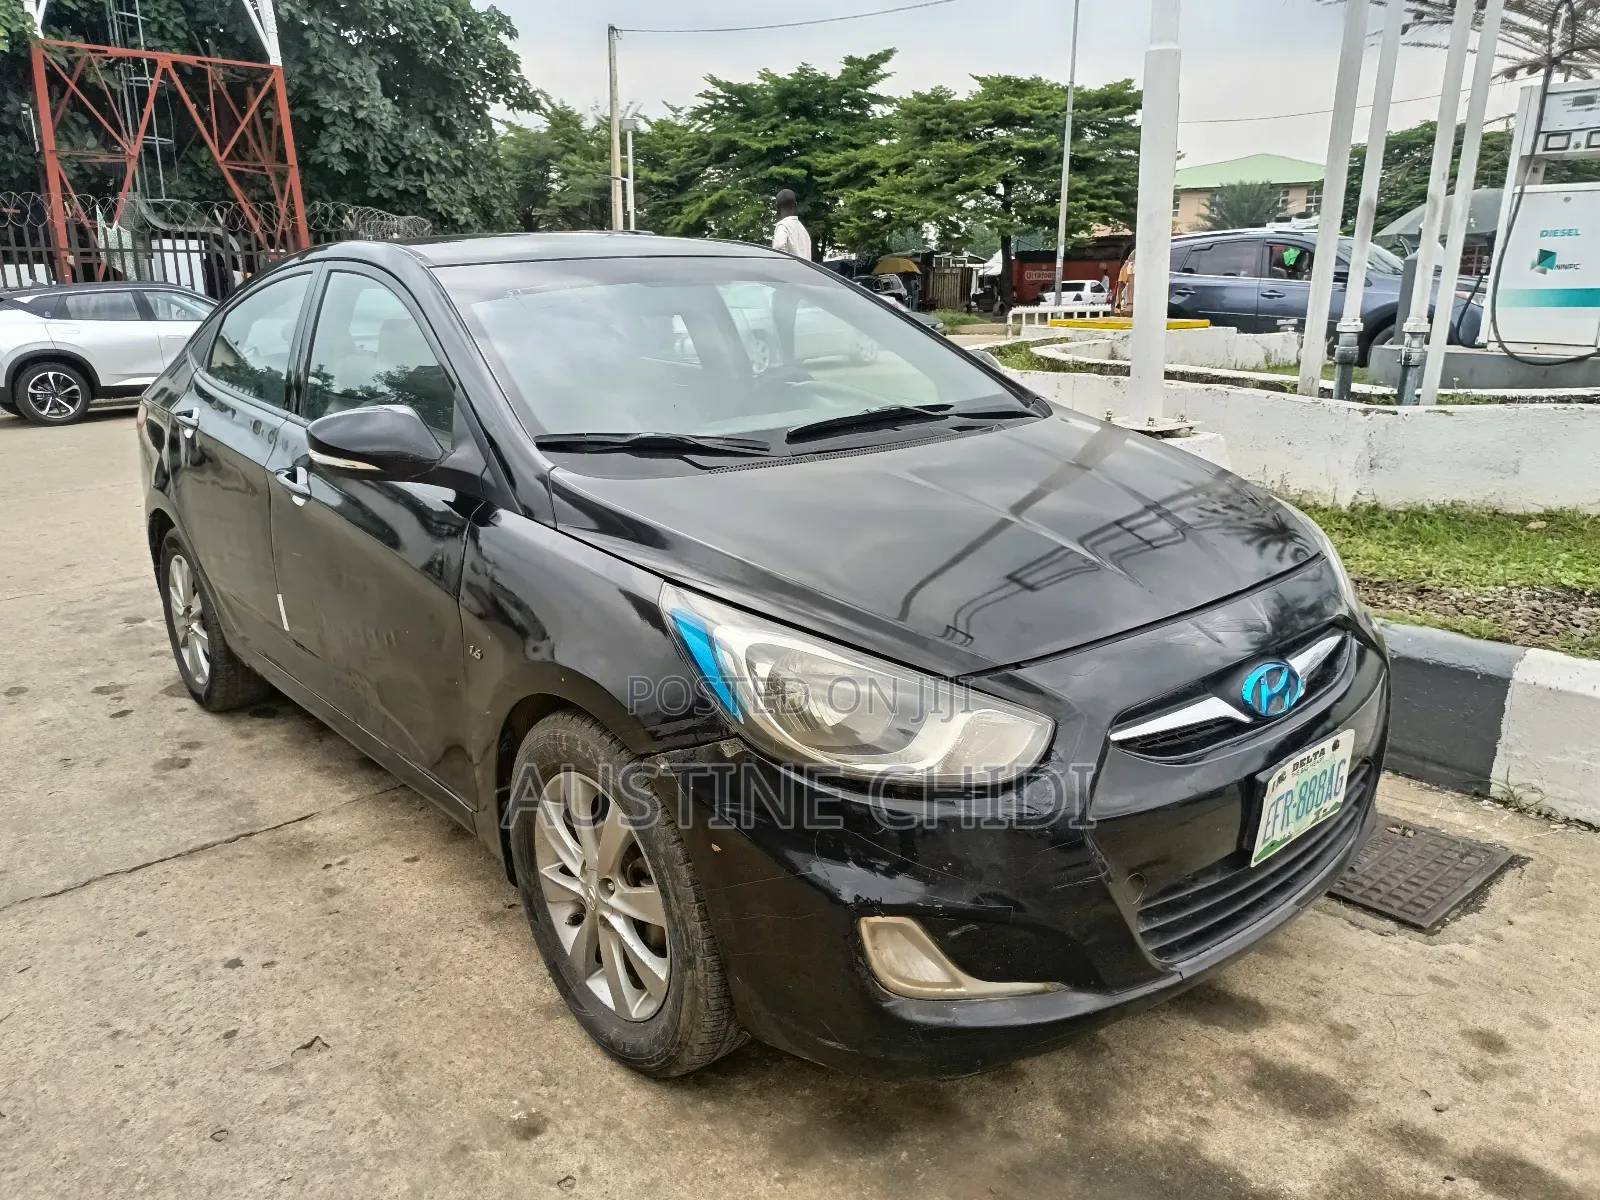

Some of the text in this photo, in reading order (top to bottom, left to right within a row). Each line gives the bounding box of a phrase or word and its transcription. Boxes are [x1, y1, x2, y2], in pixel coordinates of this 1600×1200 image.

[1540, 228, 1580, 238] DIESEL
[1291, 748, 1326, 772] DELTA
[1310, 756, 1325, 769] HEART
[1262, 758, 1347, 844] EFR-888AG
